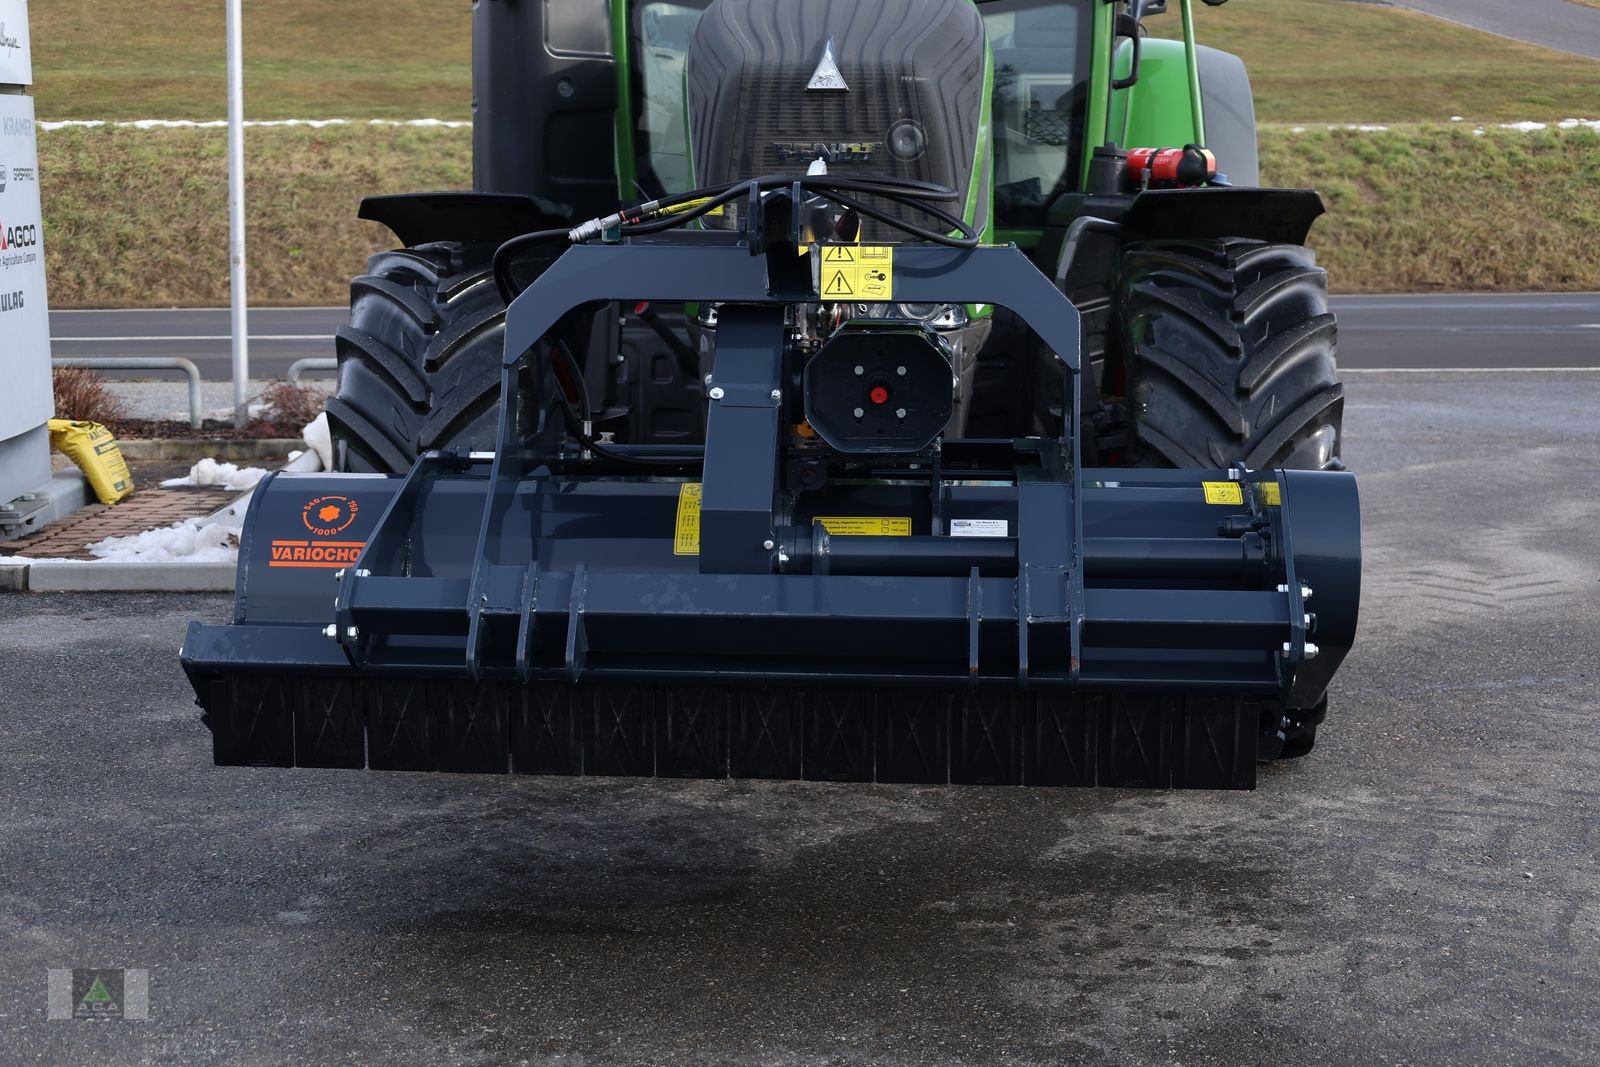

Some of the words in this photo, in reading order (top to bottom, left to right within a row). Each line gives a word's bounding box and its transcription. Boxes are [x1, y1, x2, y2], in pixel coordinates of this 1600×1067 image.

[3, 117, 32, 136] KRAMER
[7, 224, 36, 248] AGCO
[0, 290, 24, 312] ULAG
[304, 498, 320, 511] 540
[272, 547, 361, 561] VARIOCHO
